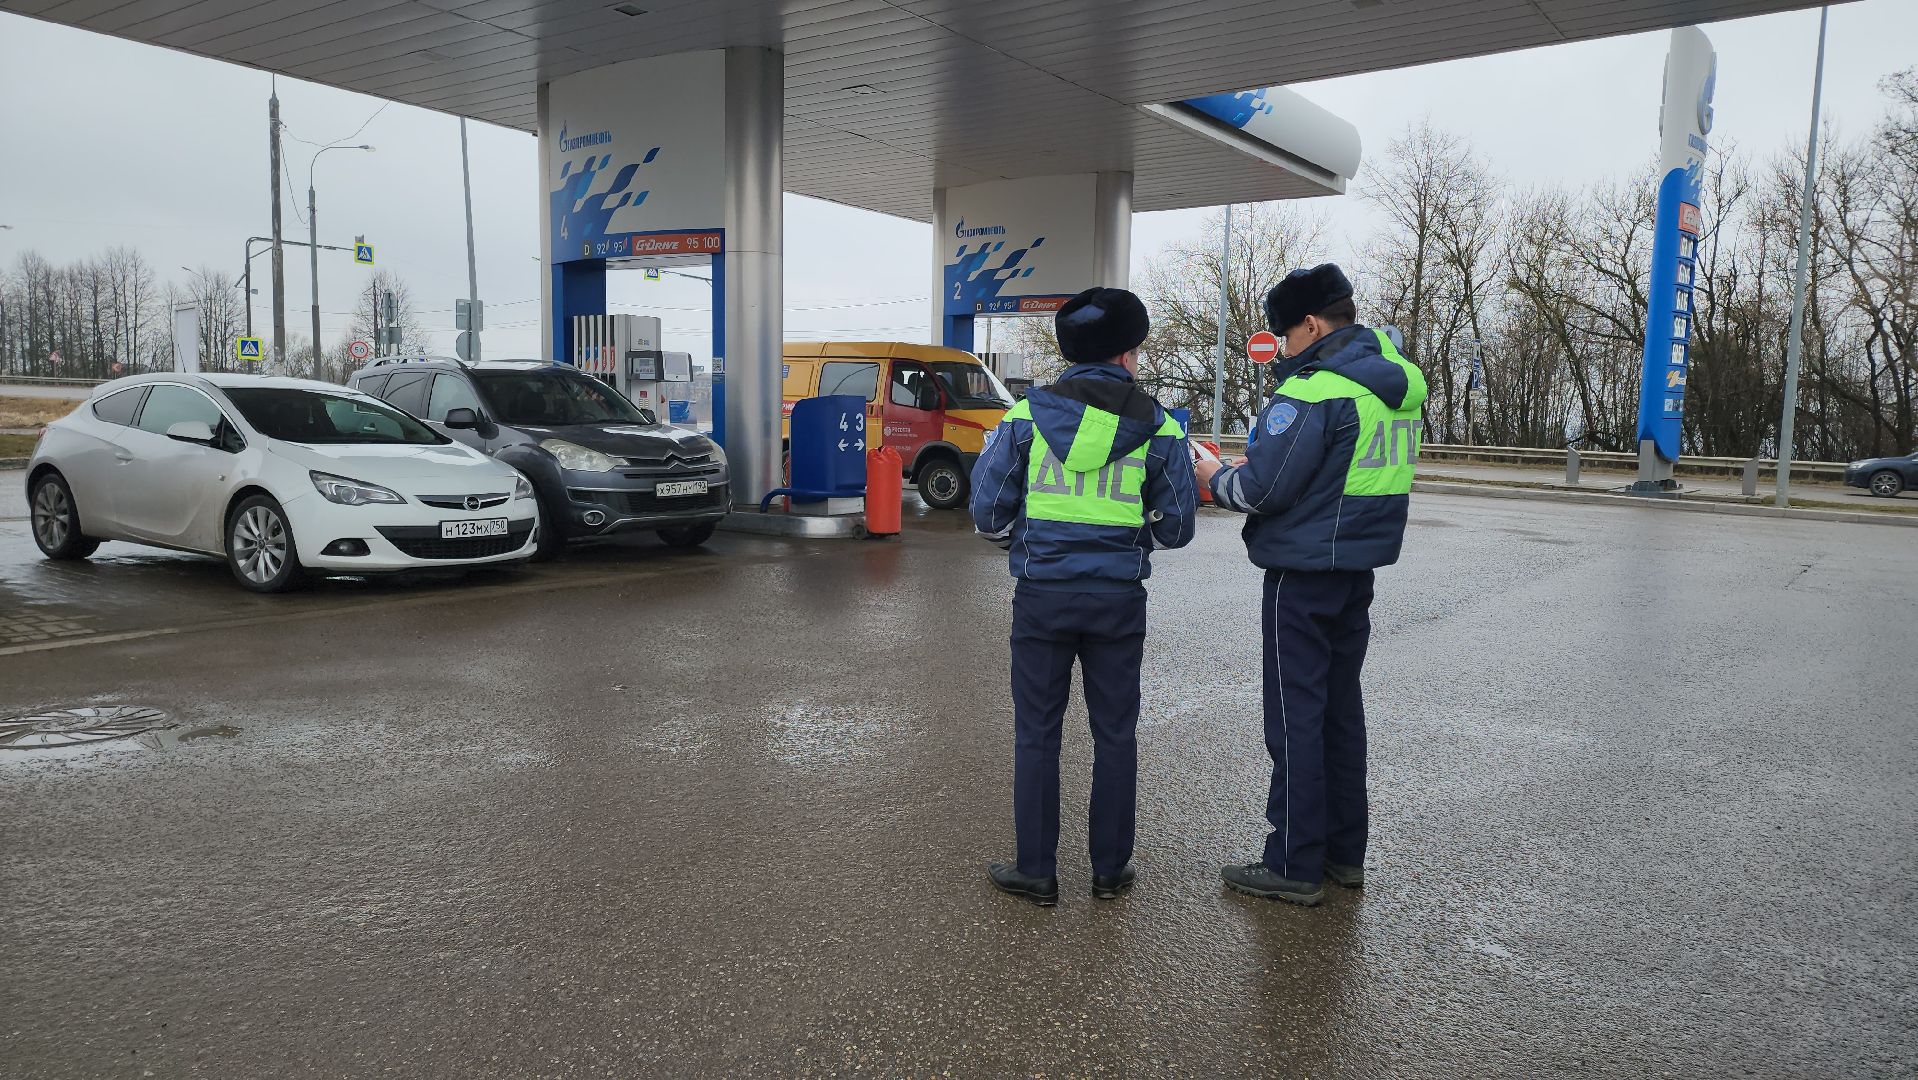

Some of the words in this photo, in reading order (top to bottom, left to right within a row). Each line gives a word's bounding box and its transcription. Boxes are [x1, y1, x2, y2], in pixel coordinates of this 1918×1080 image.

[560, 215, 569, 240] 4
[584, 244, 590, 255] D
[596, 243, 606, 255] 92
[613, 241, 623, 253] 95
[686, 237, 699, 249] 95
[703, 236, 720, 249] 100
[954, 281, 961, 300] 2
[988, 302, 997, 311] 92
[840, 412, 848, 432] 4
[856, 412, 864, 432] 3
[490, 519, 505, 530] 750
